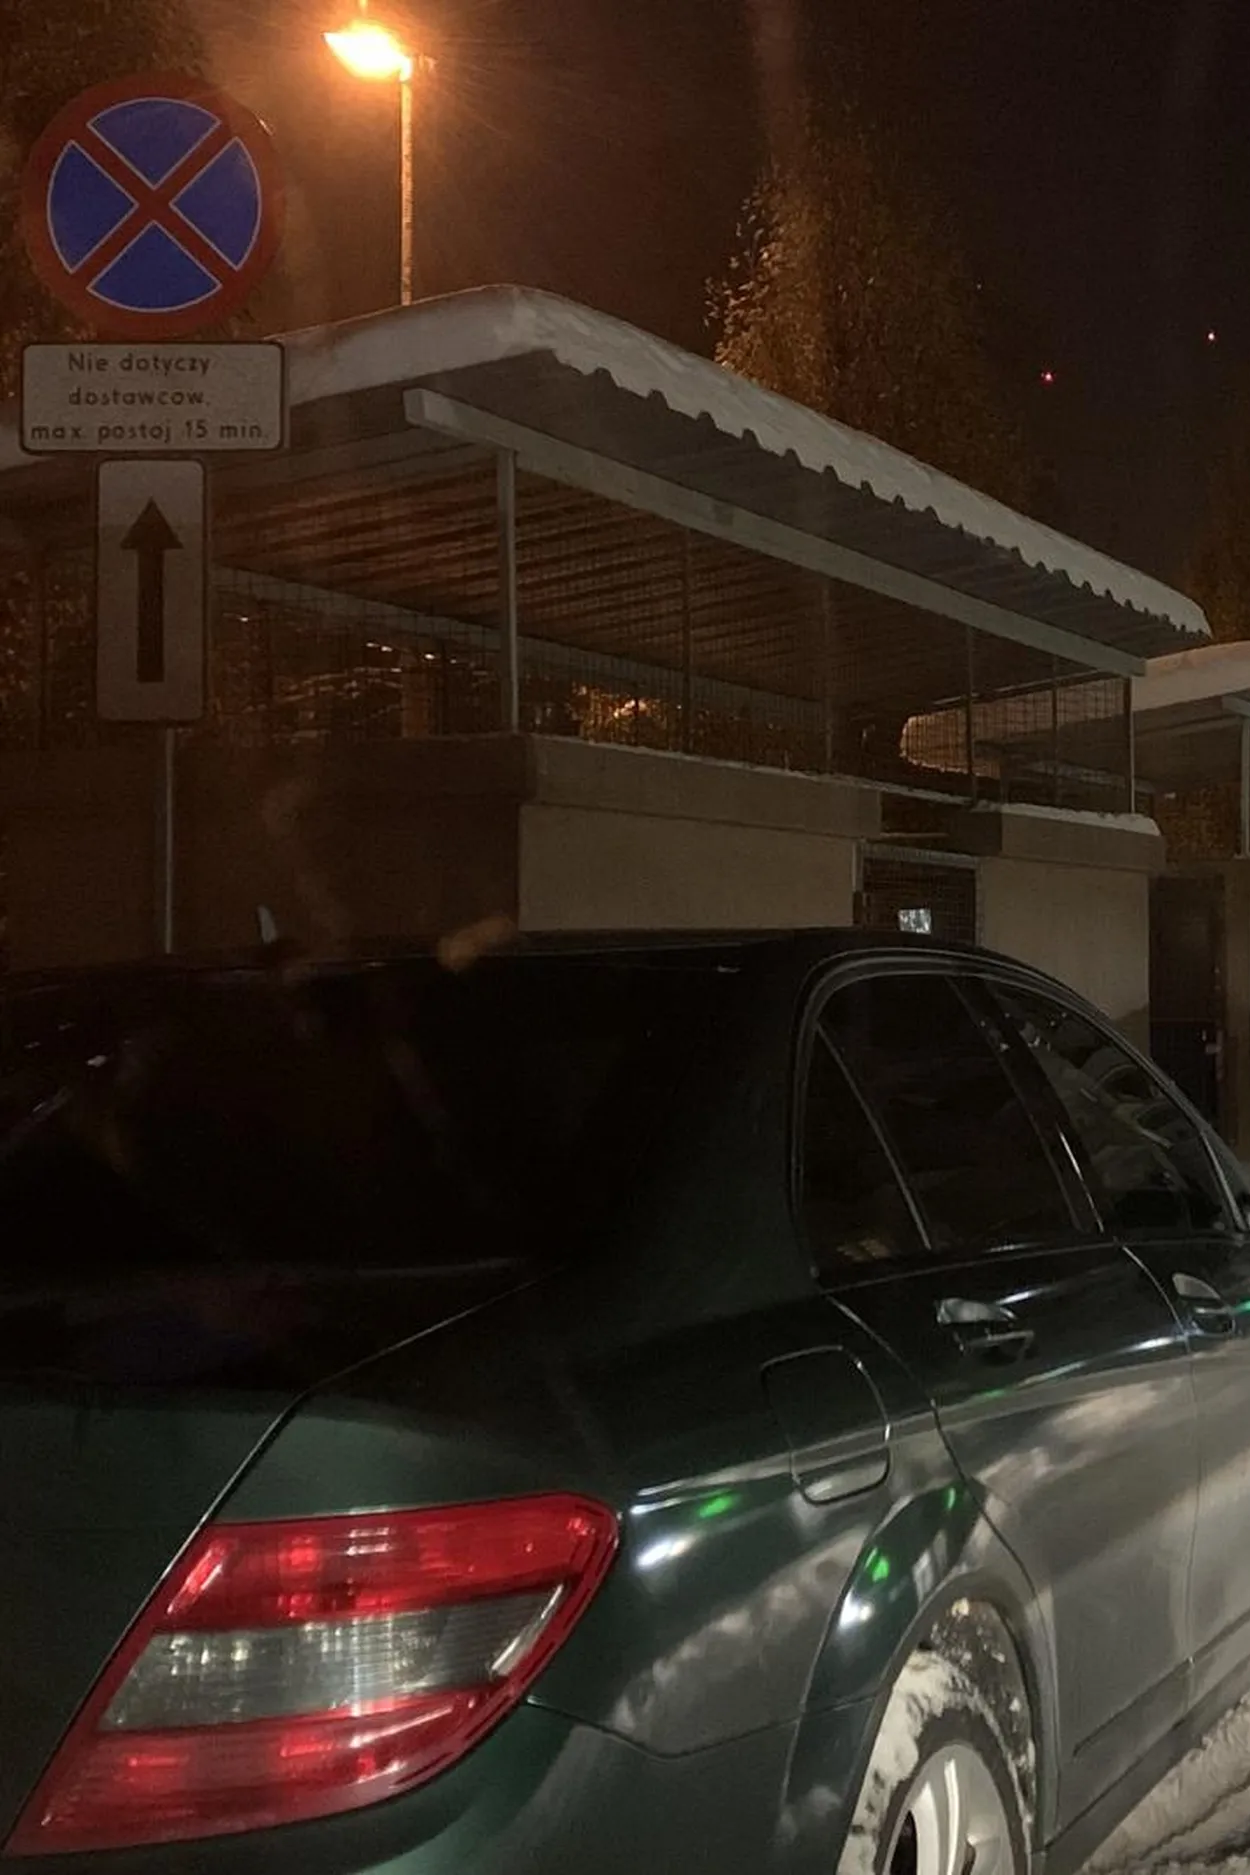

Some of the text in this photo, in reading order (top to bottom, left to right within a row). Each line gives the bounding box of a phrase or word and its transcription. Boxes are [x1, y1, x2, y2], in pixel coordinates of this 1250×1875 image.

[68, 353, 210, 376] Nie dotyczy
[99, 420, 171, 443] postoj
[186, 420, 208, 439] 15
